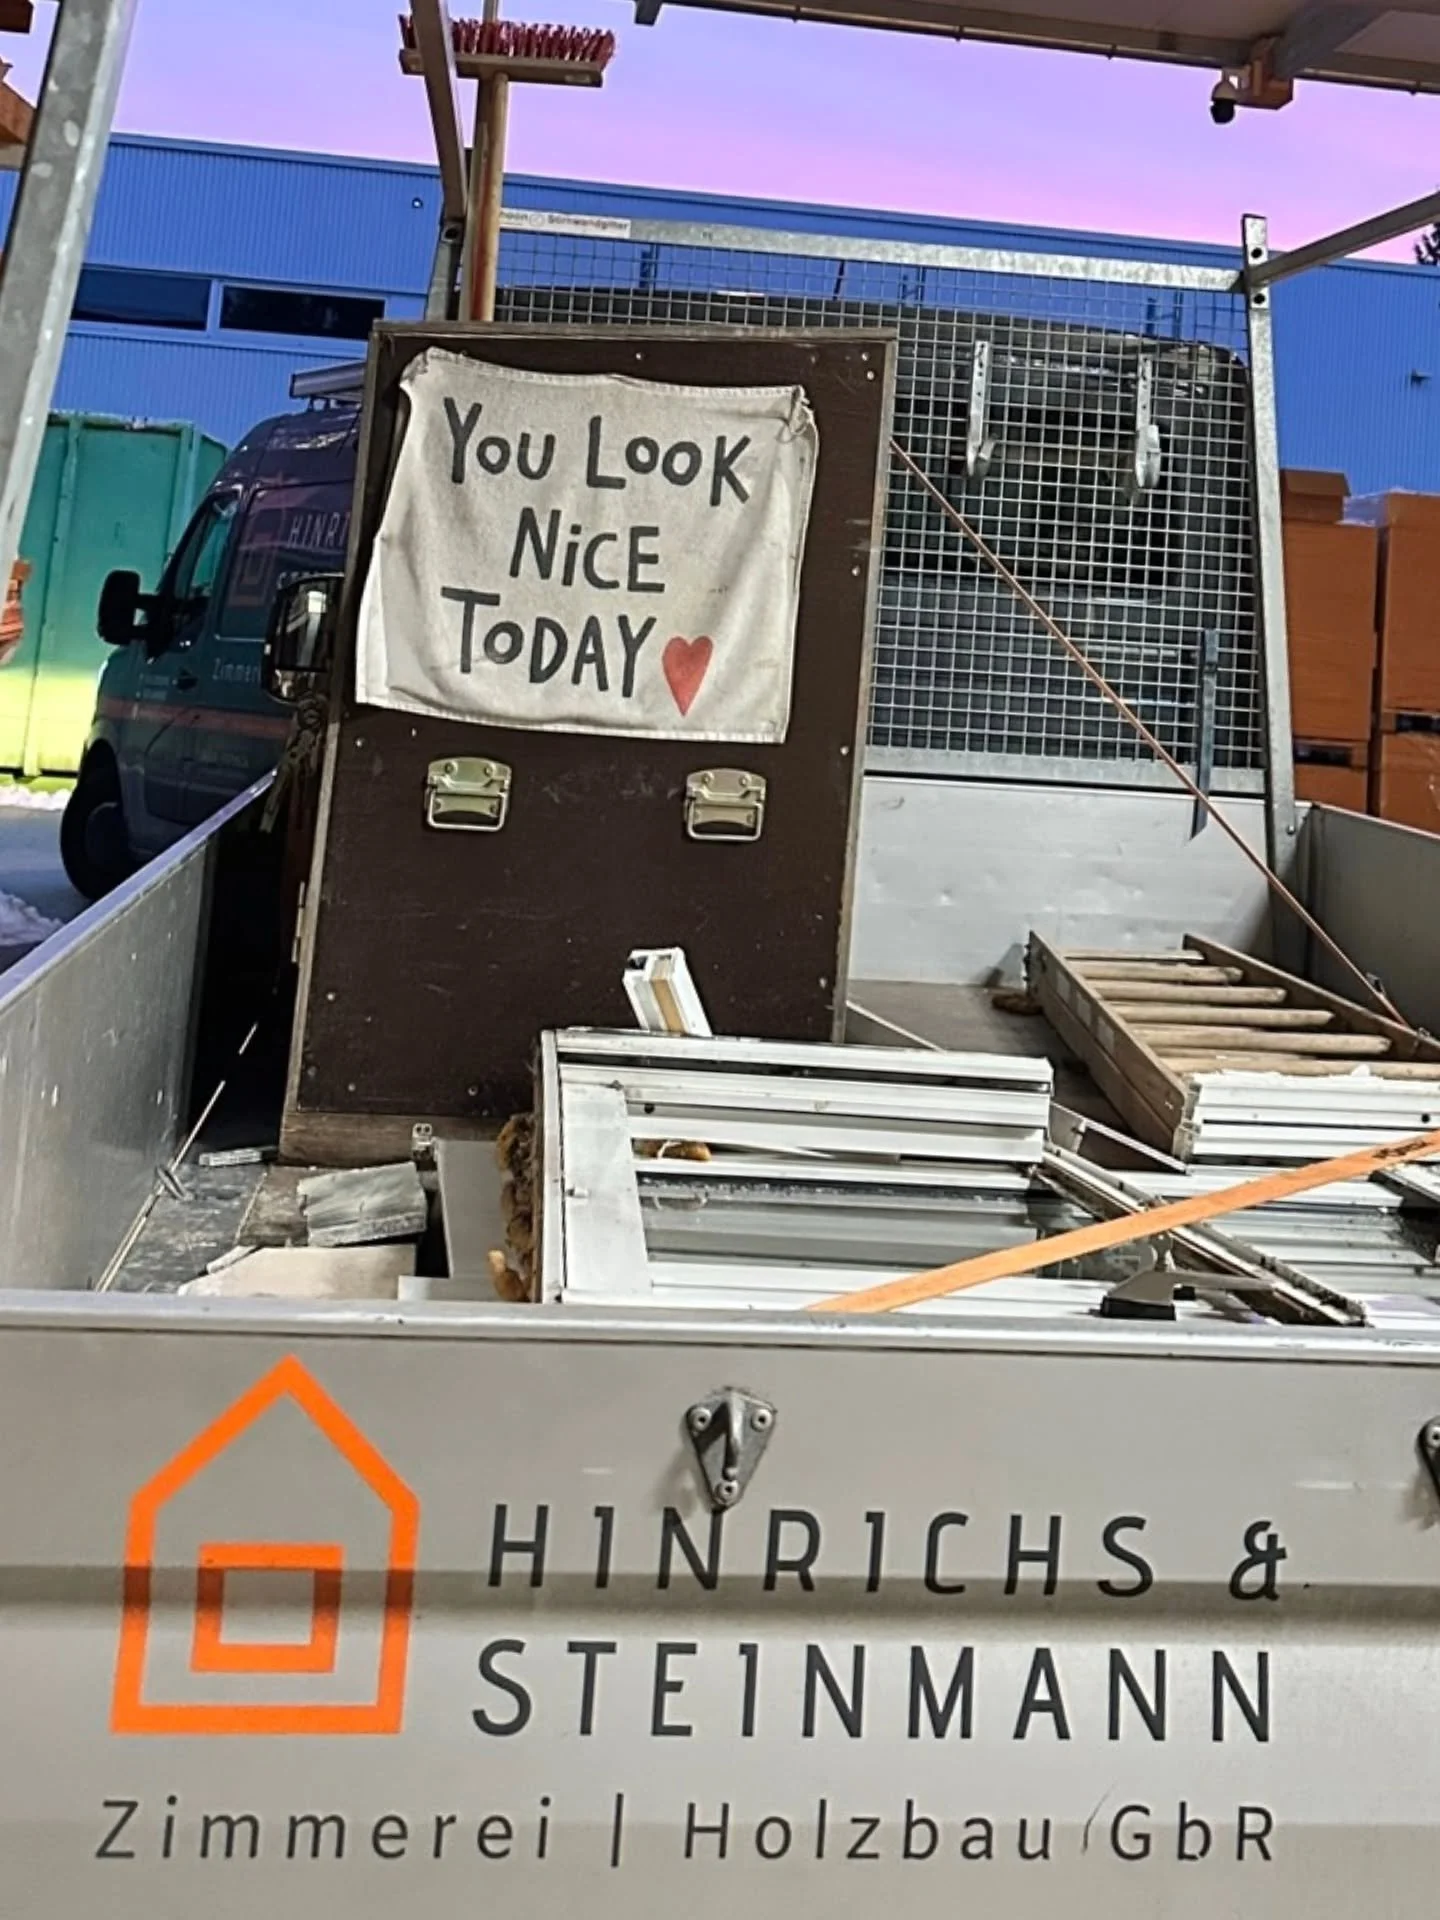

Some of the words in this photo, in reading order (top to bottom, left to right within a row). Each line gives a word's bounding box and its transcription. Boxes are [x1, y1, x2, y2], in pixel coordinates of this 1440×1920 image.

[487, 1503, 1154, 1600] HINRICHS
[1228, 1520, 1289, 1604] &
[471, 1638, 1270, 1743] STEINMANN
[95, 1794, 551, 1860] Zimmerei
[684, 1798, 1051, 1861] Holzbau
[1109, 1800, 1274, 1862] GbR
